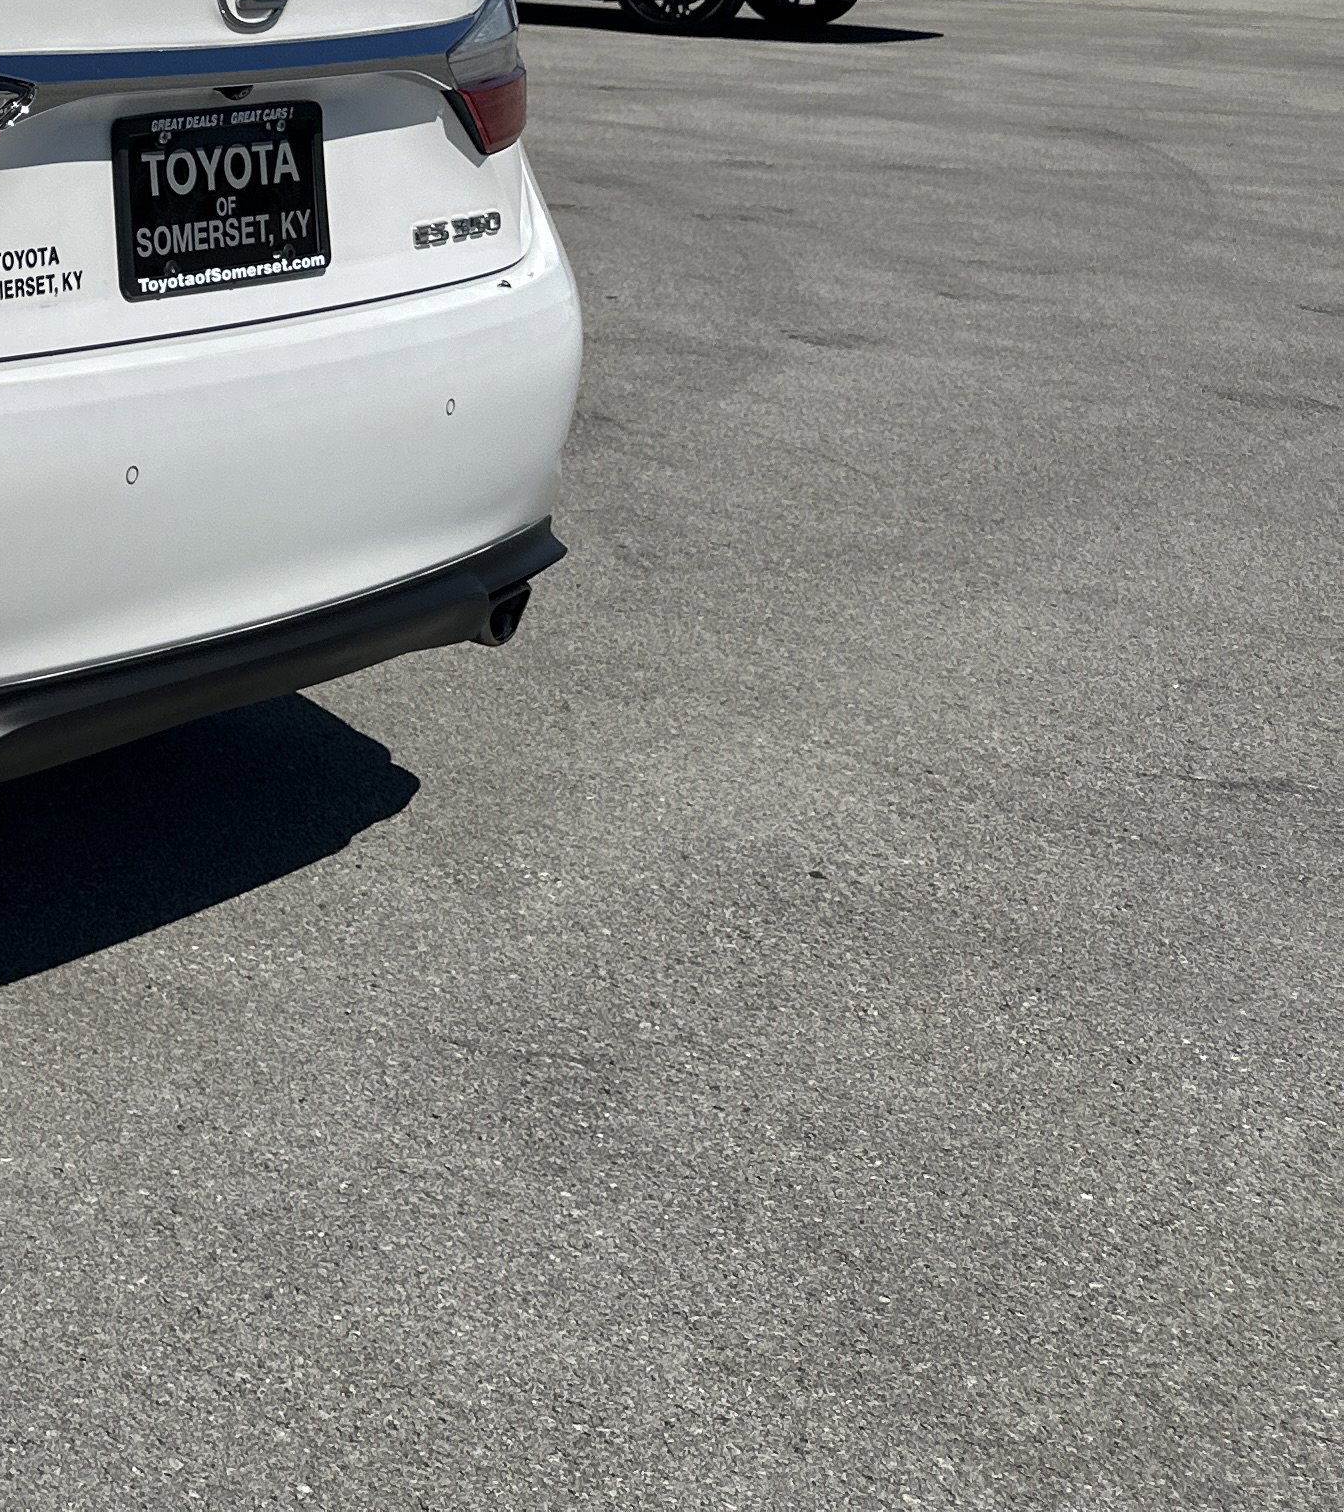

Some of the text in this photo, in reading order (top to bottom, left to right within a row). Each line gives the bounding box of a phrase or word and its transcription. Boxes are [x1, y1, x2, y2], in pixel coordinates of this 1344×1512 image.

[152, 117, 183, 132] GREAT
[230, 109, 262, 124] GREAT
[141, 139, 301, 197] TOYOTA
[216, 196, 237, 216] OF
[136, 209, 311, 258] SOMERSET, KY
[412, 211, 501, 248] ES 350
[62, 270, 83, 292] KY
[138, 254, 325, 294] ToyotaofSomerset.com
